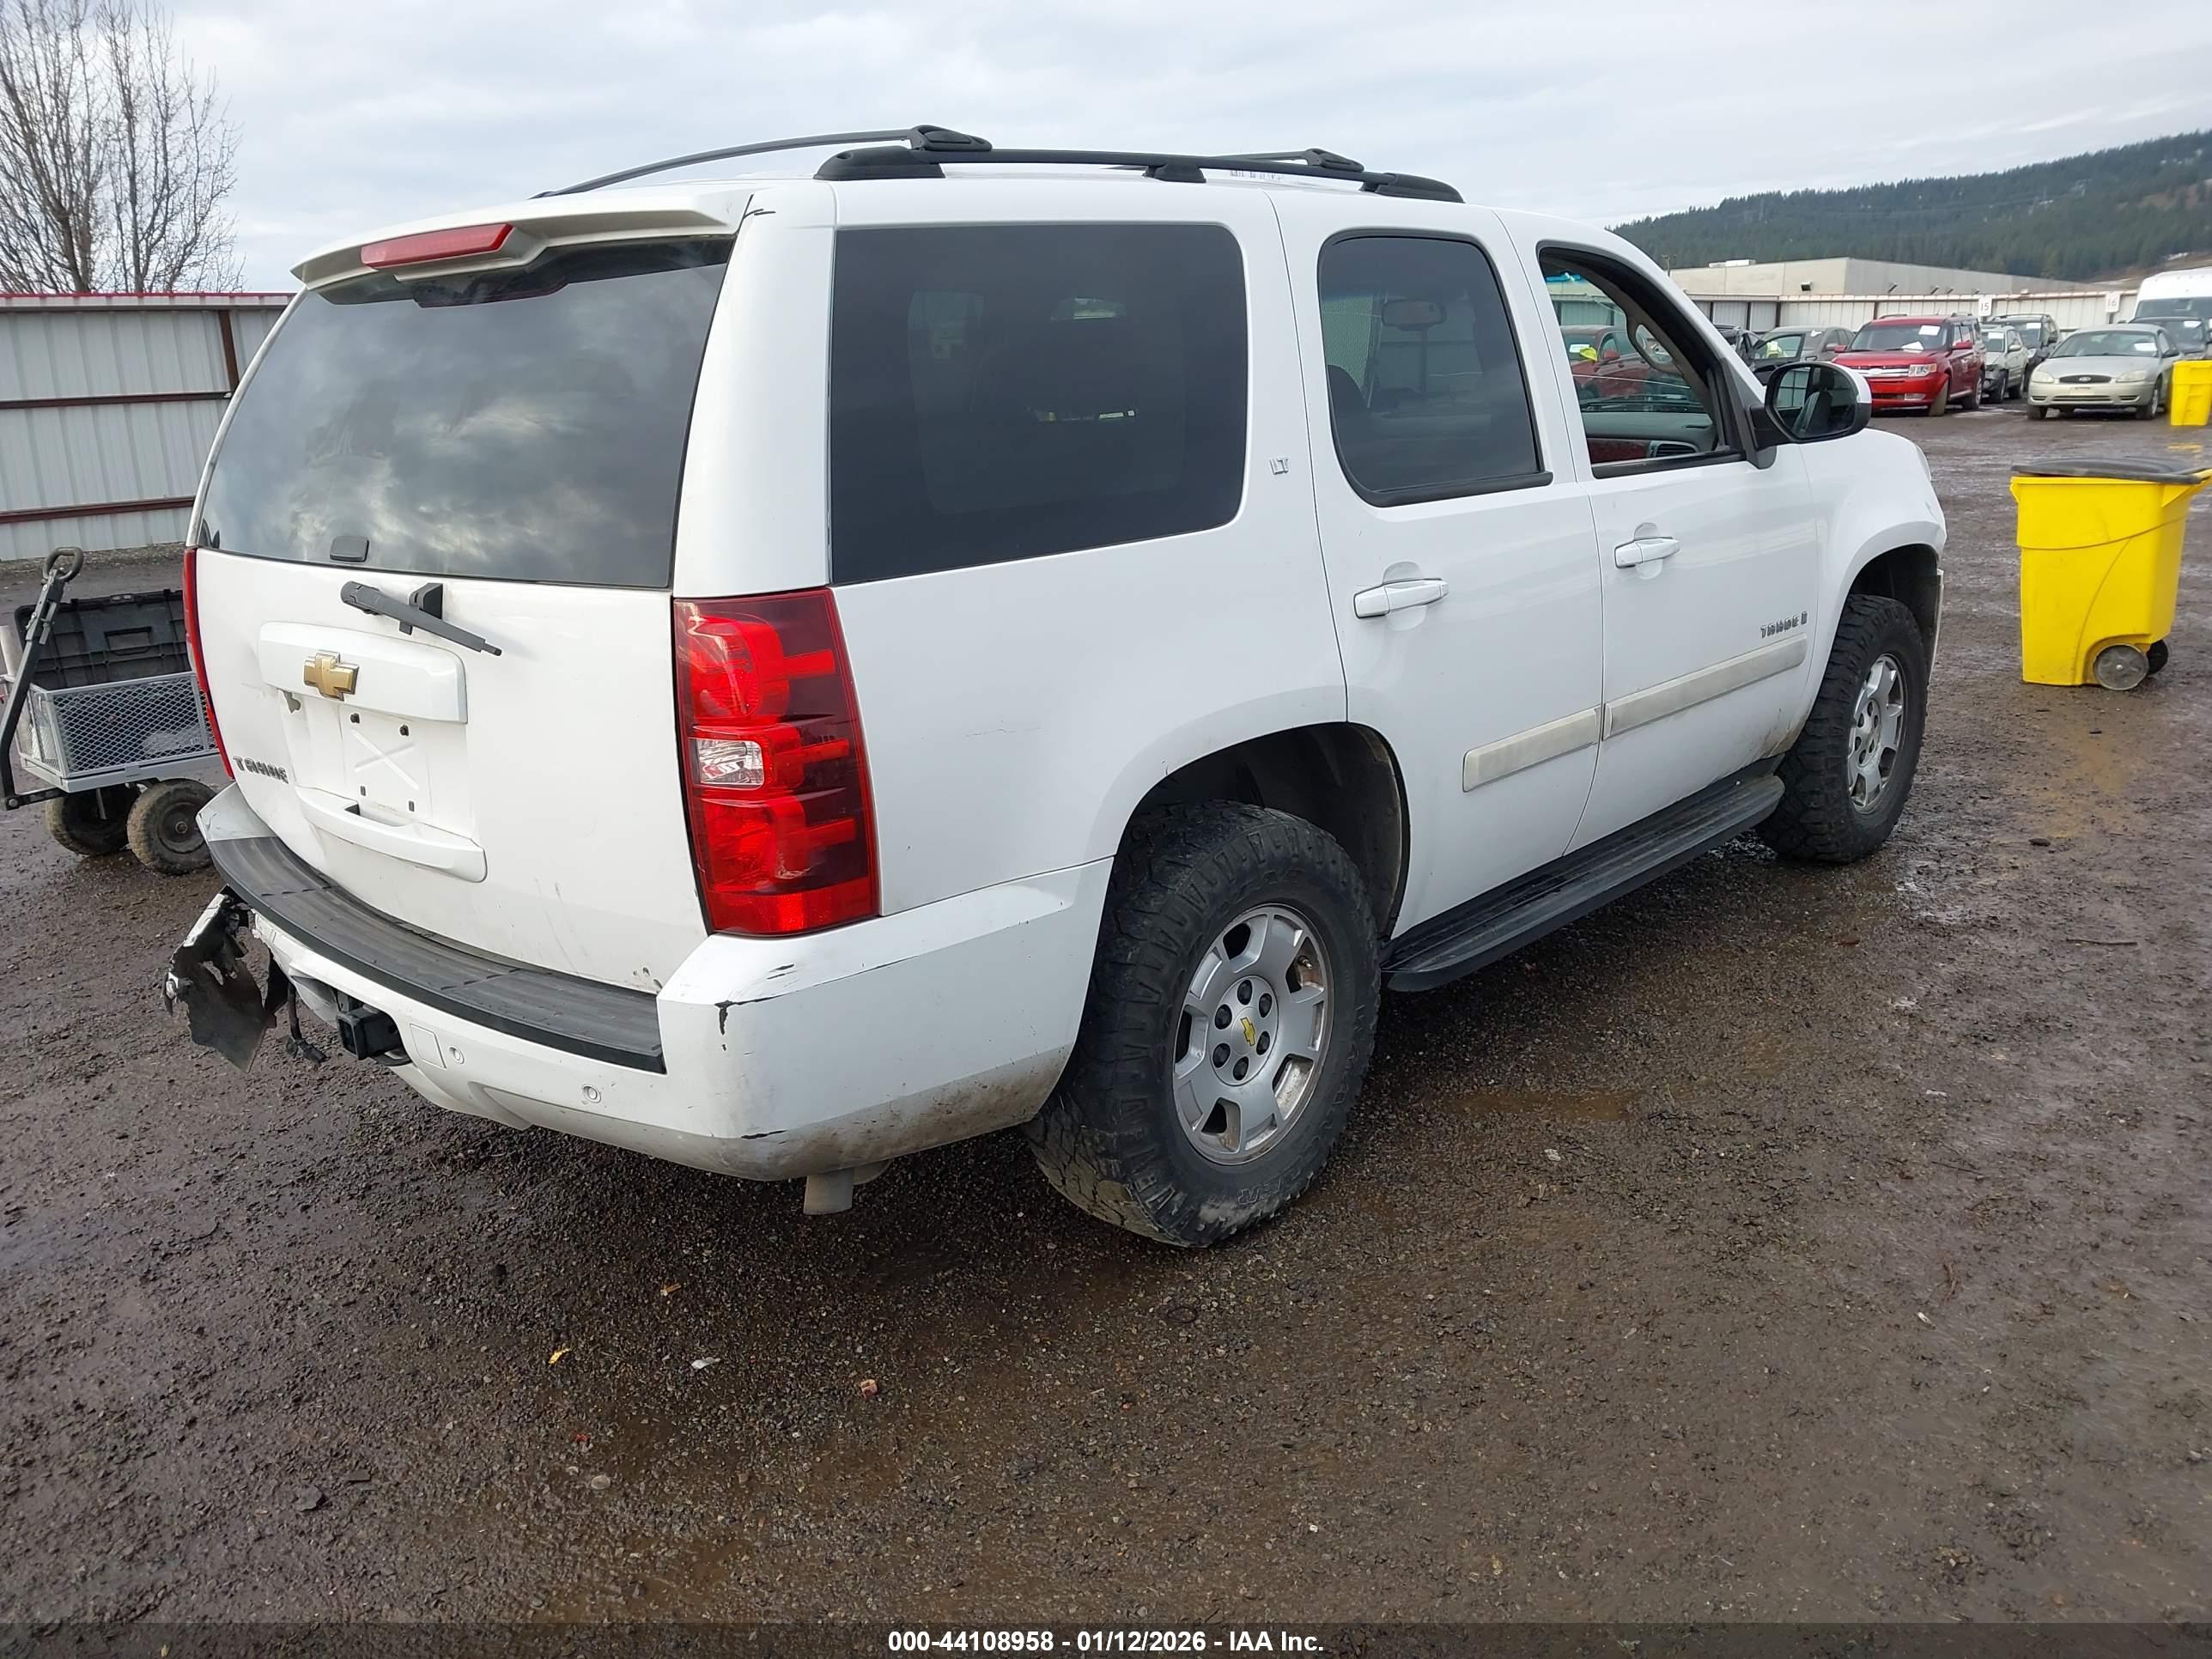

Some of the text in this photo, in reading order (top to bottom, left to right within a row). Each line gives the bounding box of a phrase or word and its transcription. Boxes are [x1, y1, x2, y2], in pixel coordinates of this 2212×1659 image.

[1980, 302, 1990, 311] 15
[1269, 458, 1289, 475] LT
[233, 755, 289, 785] TAHOE
